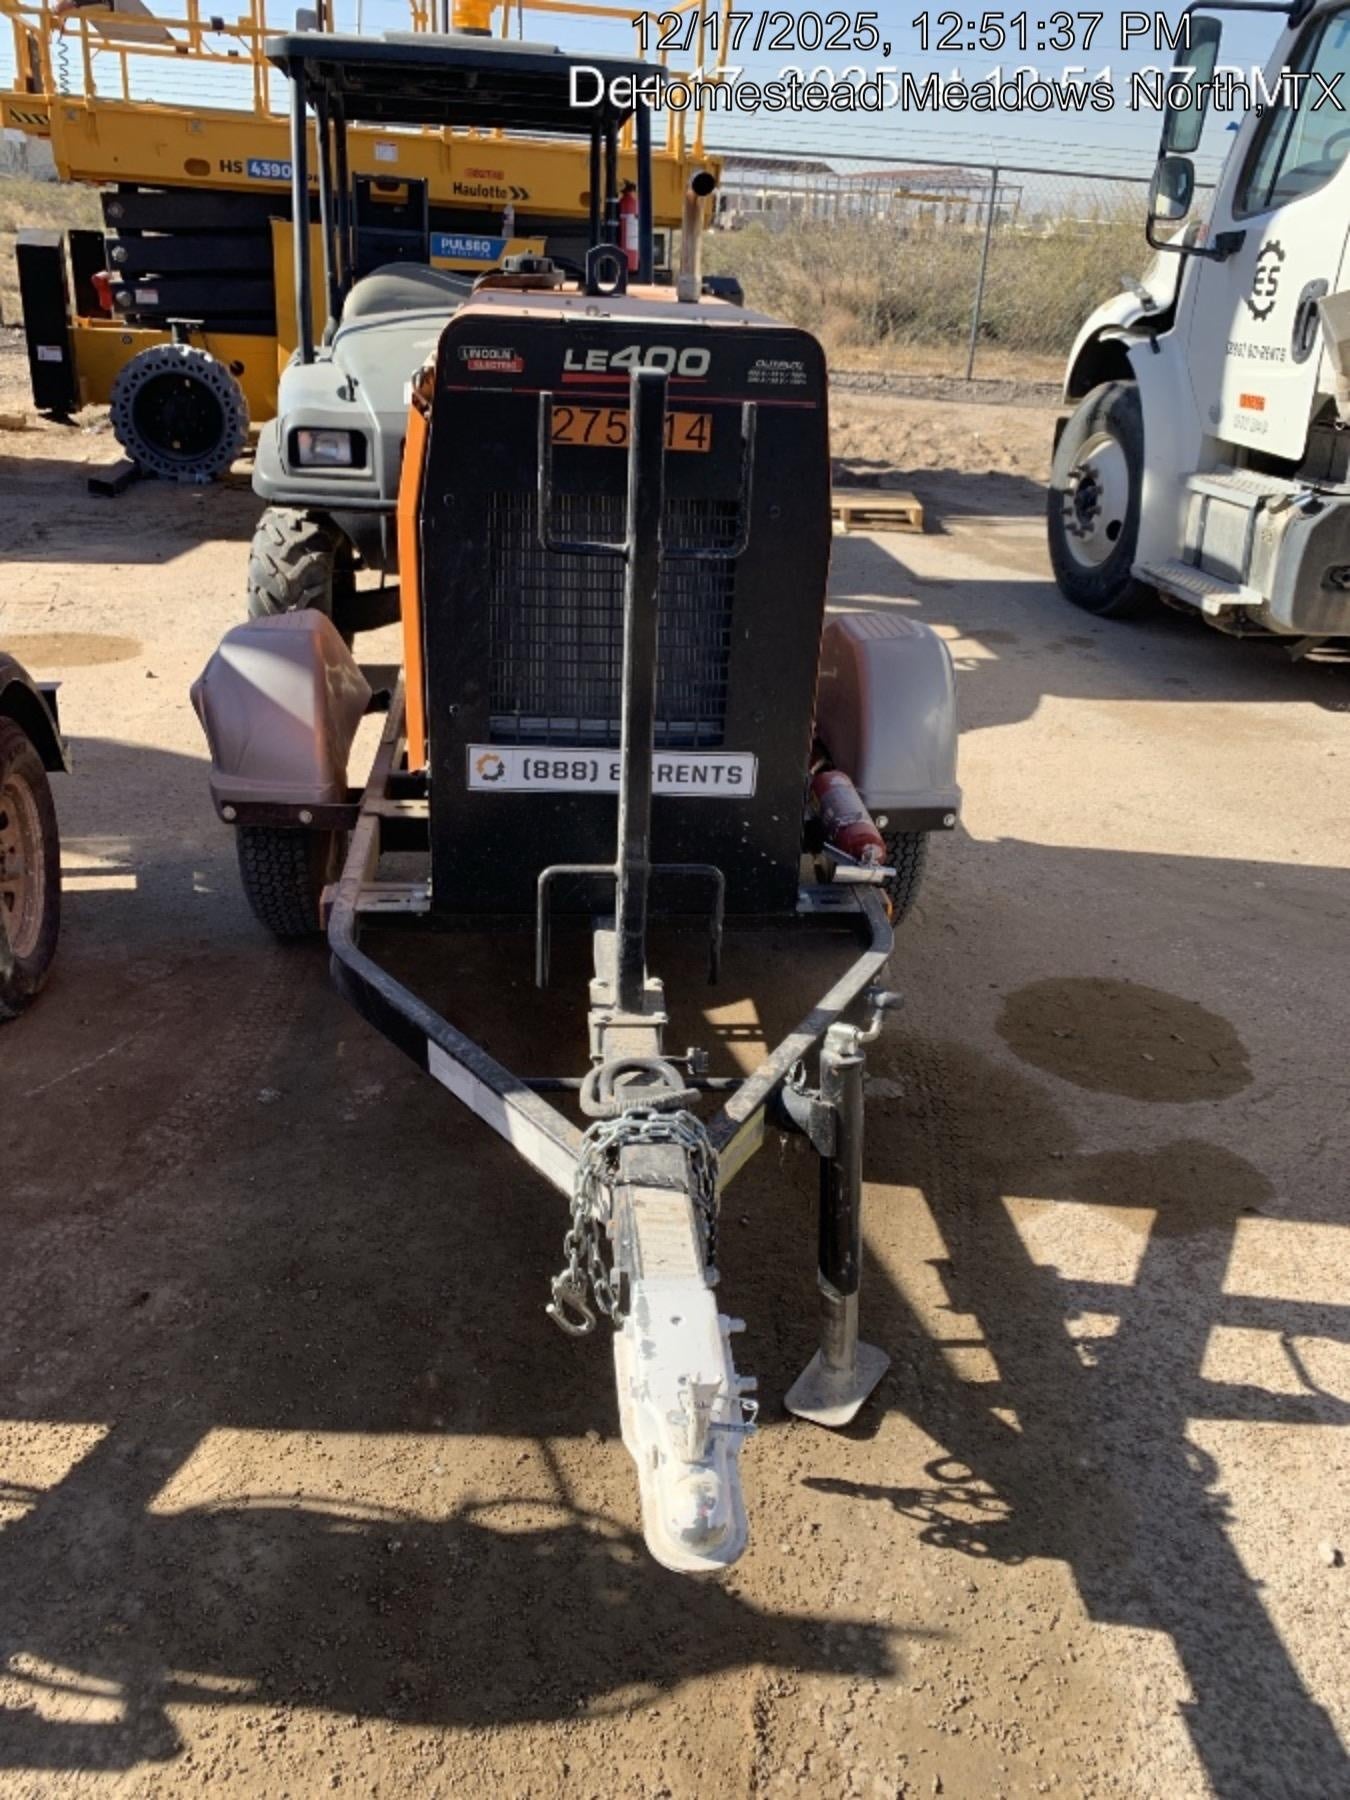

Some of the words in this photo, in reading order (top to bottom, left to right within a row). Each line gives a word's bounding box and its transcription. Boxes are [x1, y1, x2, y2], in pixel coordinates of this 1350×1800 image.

[219, 160, 243, 174] HS
[249, 161, 292, 179] 4390
[453, 182, 508, 199] Haulotte
[441, 237, 491, 253] PULSEO
[562, 345, 711, 378] LE400
[552, 406, 708, 449] 27514
[523, 758, 598, 782] (888)
[609, 762, 743, 785] 8-RENTS
